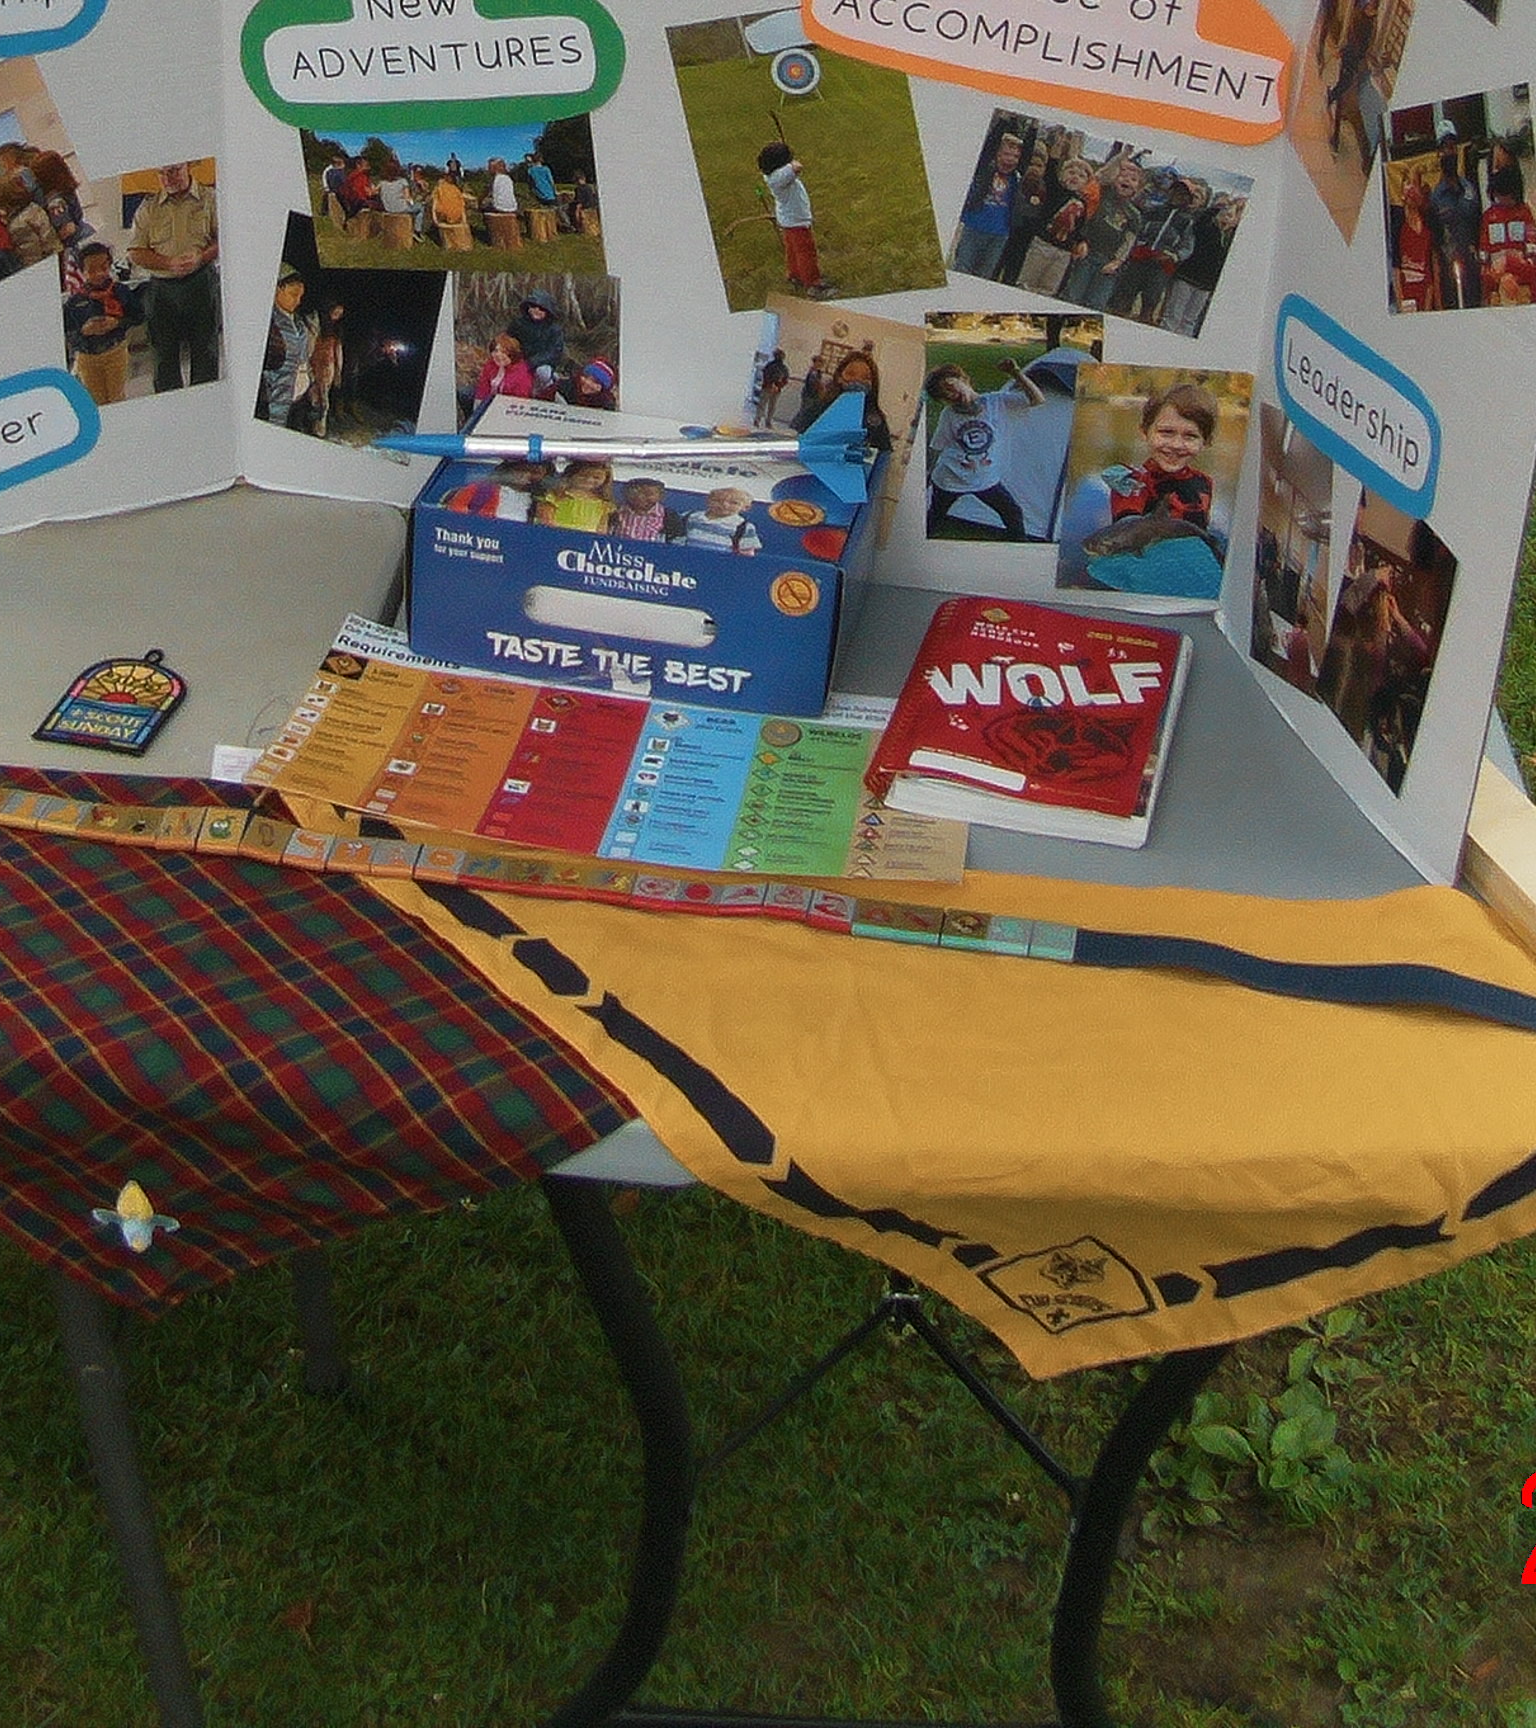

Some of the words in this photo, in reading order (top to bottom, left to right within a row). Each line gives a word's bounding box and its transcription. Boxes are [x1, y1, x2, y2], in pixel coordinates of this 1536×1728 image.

[291, 34, 585, 81] ADVENTURES
[1285, 338, 1422, 473] Leadership
[434, 525, 474, 547] Thank
[476, 535, 501, 551] you
[587, 540, 645, 567] Miss
[556, 549, 698, 591] Chocolate
[582, 575, 670, 598] FUNDRAISING
[337, 633, 463, 672] Requirements
[485, 630, 584, 668] TASTE
[591, 648, 652, 679] THE
[663, 660, 752, 694] BEST
[924, 661, 1163, 710] WOLF
[57, 718, 138, 739] SUNDAY
[83, 709, 146, 728] SCOUT
